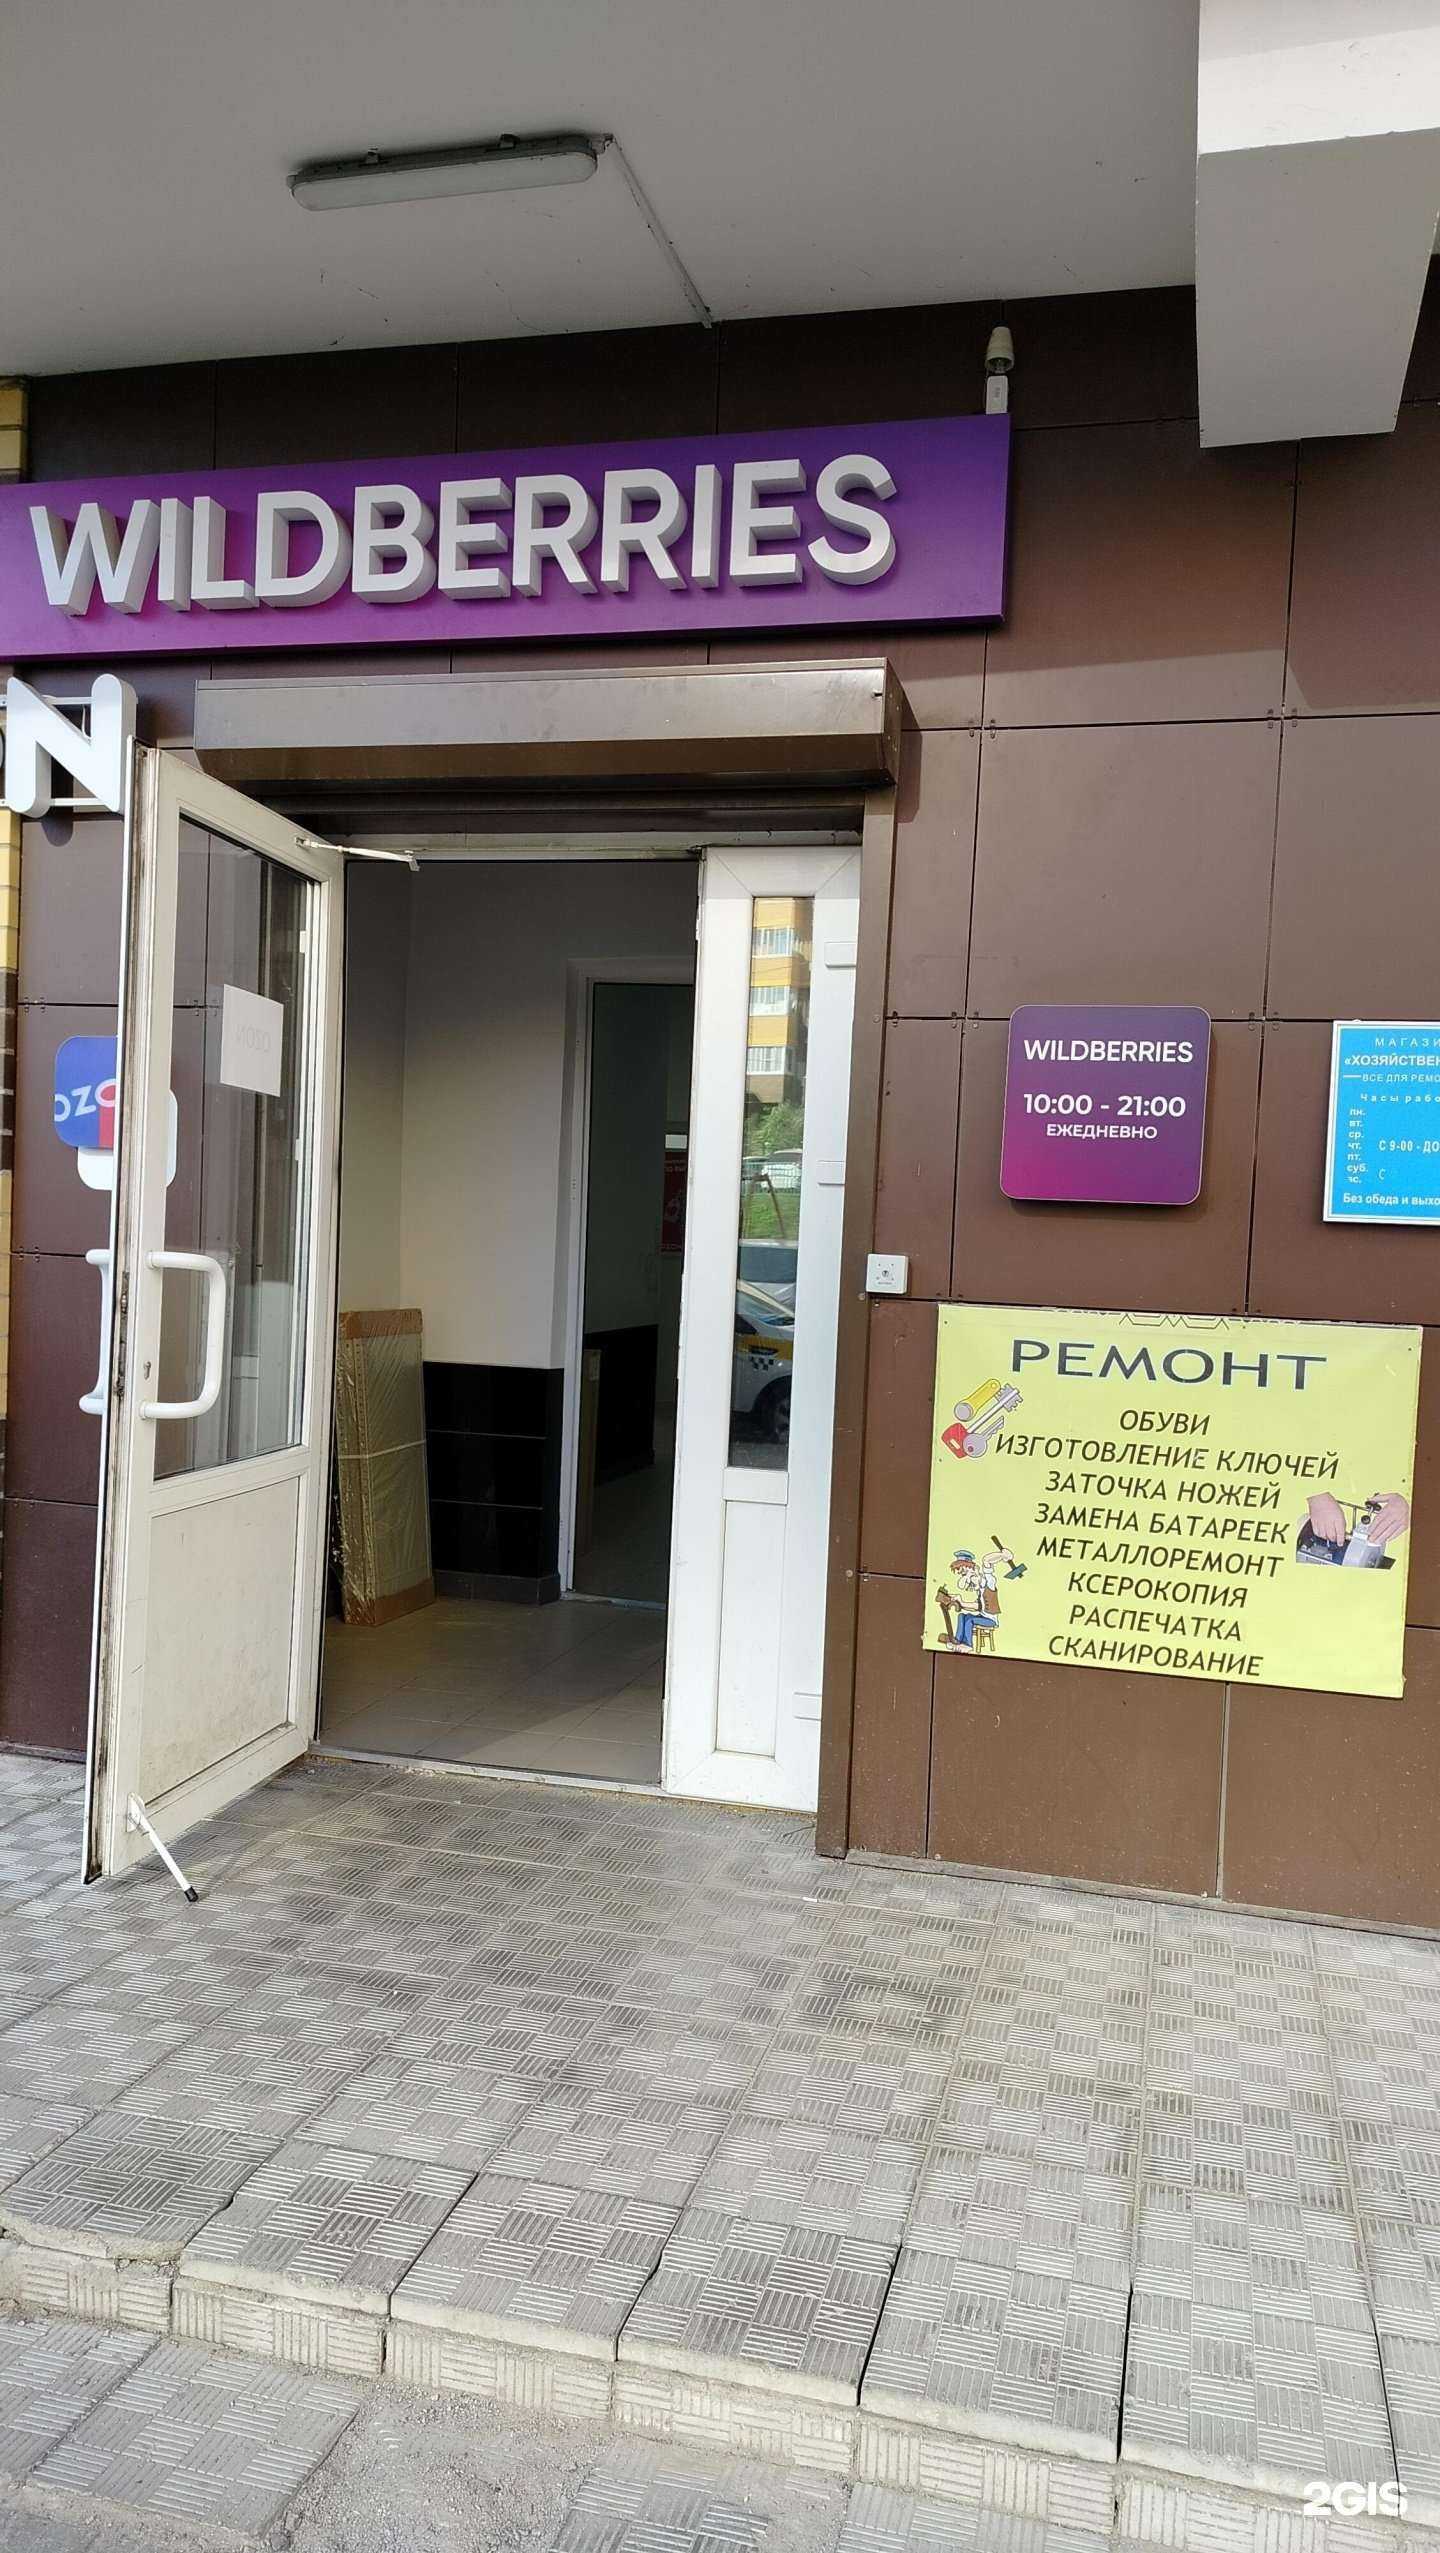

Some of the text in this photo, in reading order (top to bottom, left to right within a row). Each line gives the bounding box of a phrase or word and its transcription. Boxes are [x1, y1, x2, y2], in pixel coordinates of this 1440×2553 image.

[30, 454, 898, 616] WILDBERRIES
[1023, 1039, 1194, 1063] WILDBERRIES
[1386, 1073, 1408, 1084] ДЛЯ
[1023, 1093, 1093, 1115] 10:00
[1117, 1095, 1187, 1118] 21:00
[1361, 1092, 1399, 1103] Часы
[1046, 1123, 1158, 1140] ЕЖЕДНЕВНО
[1389, 1140, 1414, 1153] 9-00
[1343, 1192, 1363, 1205] Без
[1365, 1193, 1399, 1206] обеда
[1011, 1339, 1327, 1390] РЕМОНТ
[1119, 1409, 1210, 1436] ОБУВИ
[995, 1432, 1339, 1480] ИЗГОТОВЛЕНИЕ КЛЮЧЕЙ
[1045, 1470, 1281, 1510] ЗАТОЧКА НОЖЕЙ
[1034, 1503, 1290, 1545] ЗАМЕНА БАТАРЕЕК
[1036, 1537, 1285, 1578] МЕТАЛЛОРЕМОНТ
[1068, 1571, 1248, 1609] КСЕРОКОПИЯ
[1069, 1605, 1242, 1642] РАСПЕЧАТКА
[1048, 1636, 1264, 1677] СКАНИРОВАНИЕ
